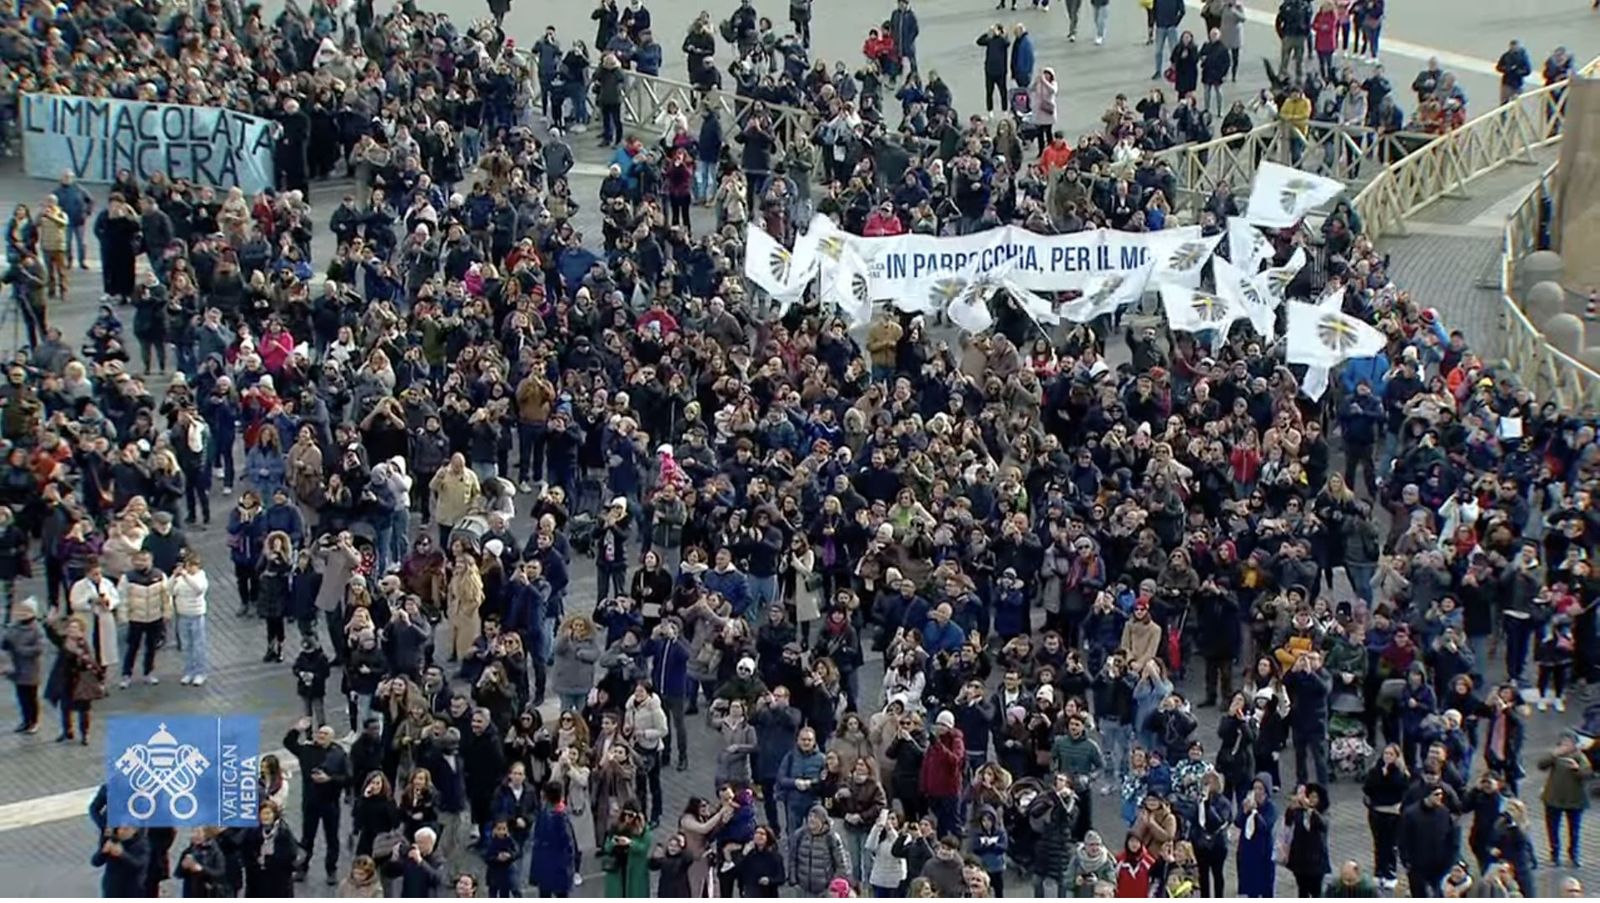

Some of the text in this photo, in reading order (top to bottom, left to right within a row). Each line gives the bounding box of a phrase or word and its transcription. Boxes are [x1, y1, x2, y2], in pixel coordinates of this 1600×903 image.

[25, 96, 275, 154] L'IMMACOLATA
[887, 253, 906, 279] IN
[1051, 247, 1090, 272] PER
[1098, 245, 1115, 270] IL
